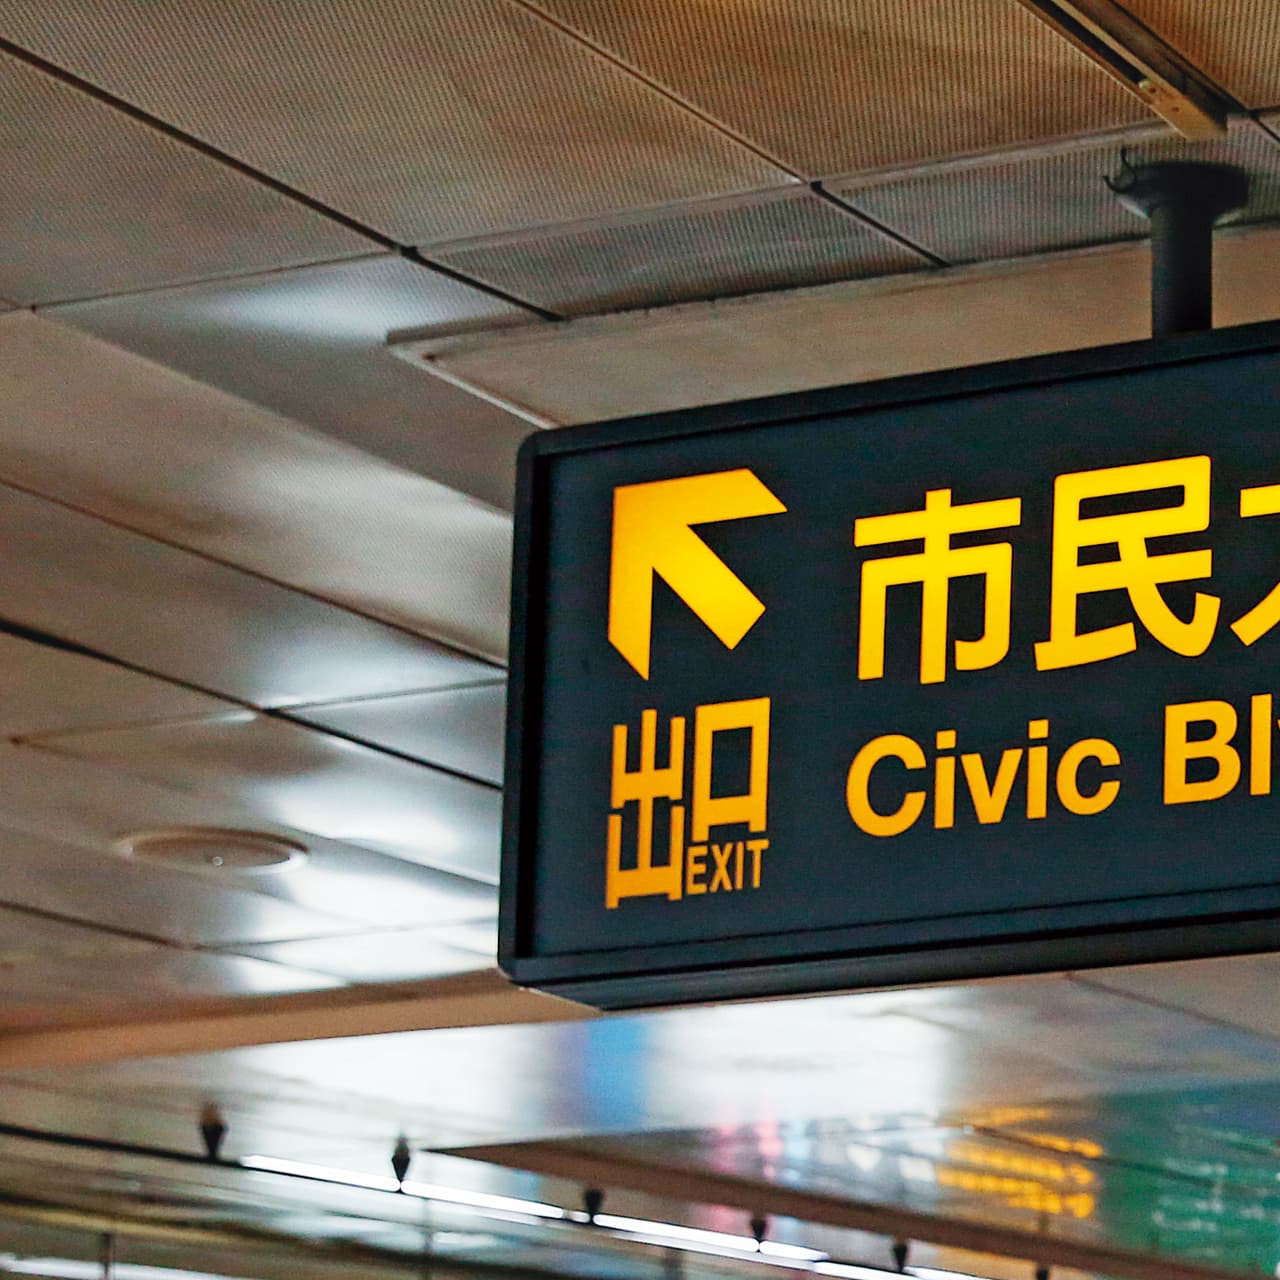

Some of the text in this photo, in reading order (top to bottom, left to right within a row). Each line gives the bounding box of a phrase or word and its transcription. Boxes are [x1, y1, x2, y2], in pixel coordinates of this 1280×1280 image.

[605, 696, 771, 909] 出口
[846, 718, 1122, 837] Civic
[686, 838, 771, 895] EXIT
